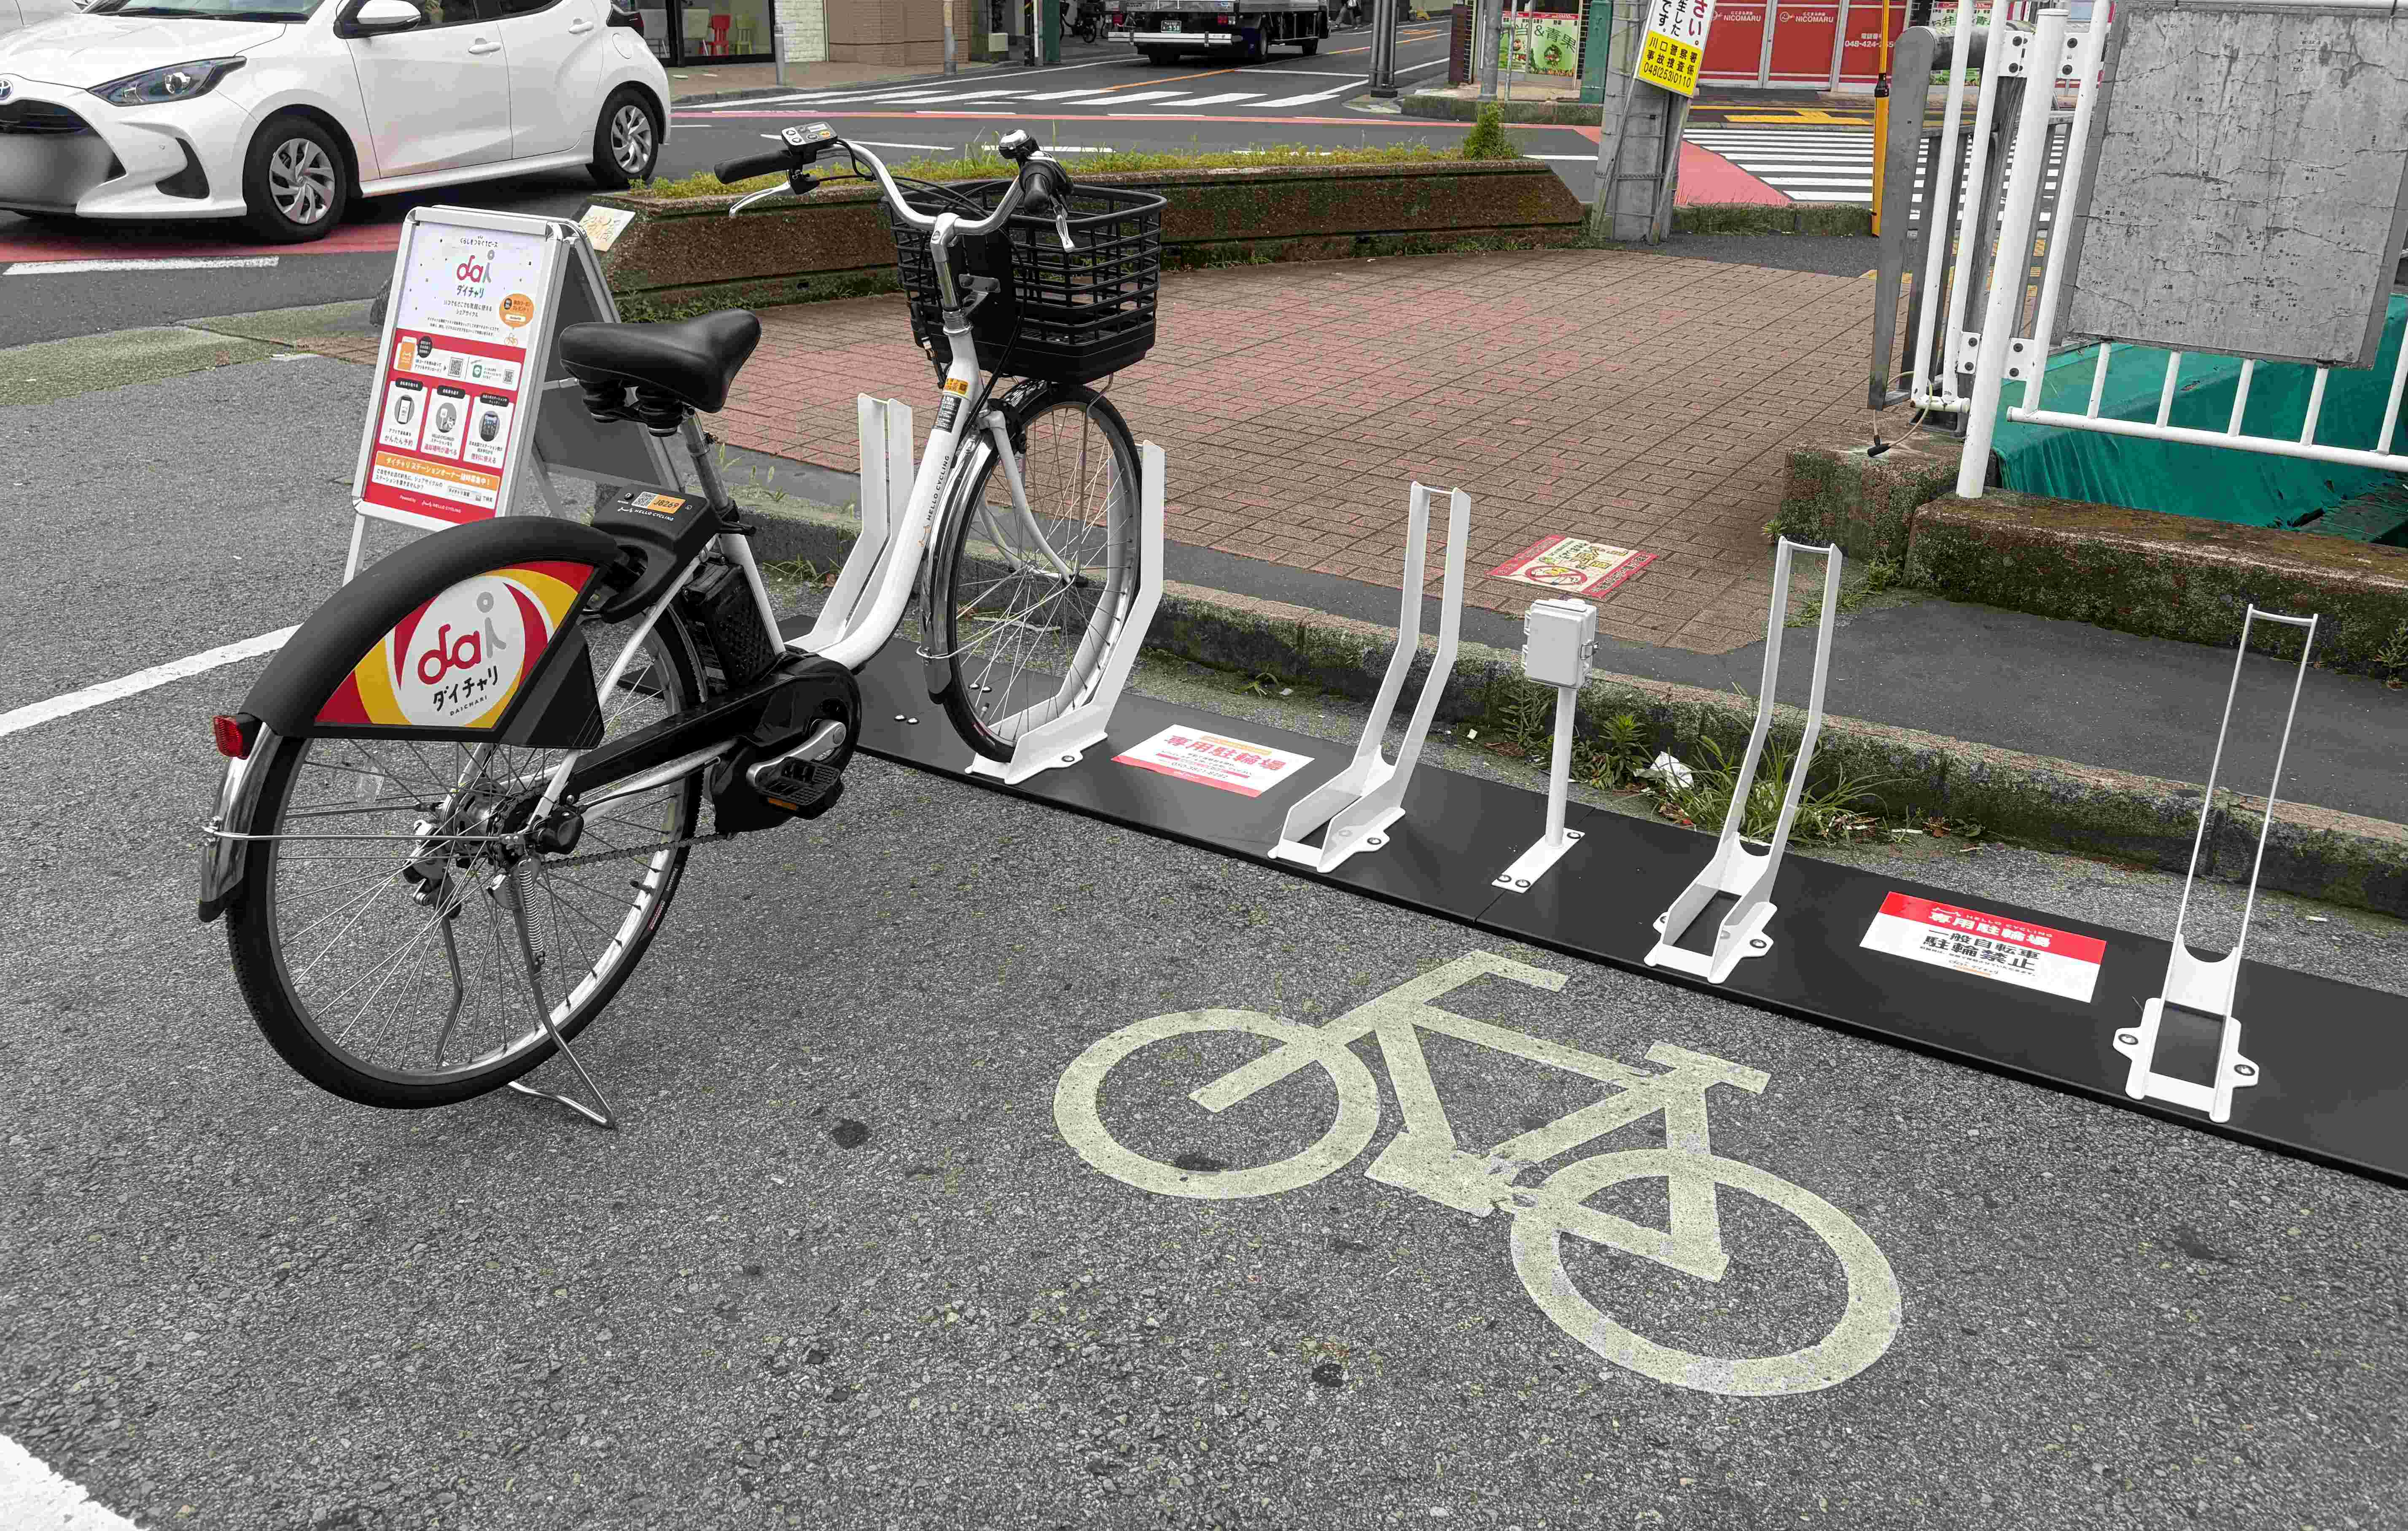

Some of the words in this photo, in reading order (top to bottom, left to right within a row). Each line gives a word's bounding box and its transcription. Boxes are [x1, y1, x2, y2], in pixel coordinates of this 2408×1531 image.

[1647, 50, 1695, 75] 事故捜査係
[1649, 37, 1698, 63] 川口警察署
[1644, 62, 1691, 88] 048(253)0110
[456, 250, 495, 283] dai
[457, 285, 485, 298] ダイチャリ
[385, 436, 413, 447] かんたん予約
[471, 453, 496, 464] 便利に使える
[926, 493, 938, 520] HELLO
[936, 455, 950, 491] CYCLING
[653, 512, 675, 521] CYCLING
[417, 592, 507, 685] dai
[433, 665, 498, 712] ダイチャリ
[449, 695, 488, 716] DAICHARI
[1164, 735, 1286, 771] 専用駐輪場
[1929, 912, 2051, 948] 専用駐輪場
[1966, 914, 2002, 925] HELLO
[2006, 924, 2053, 938] CYCLING
[1922, 935, 2035, 971] 駐輪禁止
[1929, 928, 2040, 960] 一般自転車
